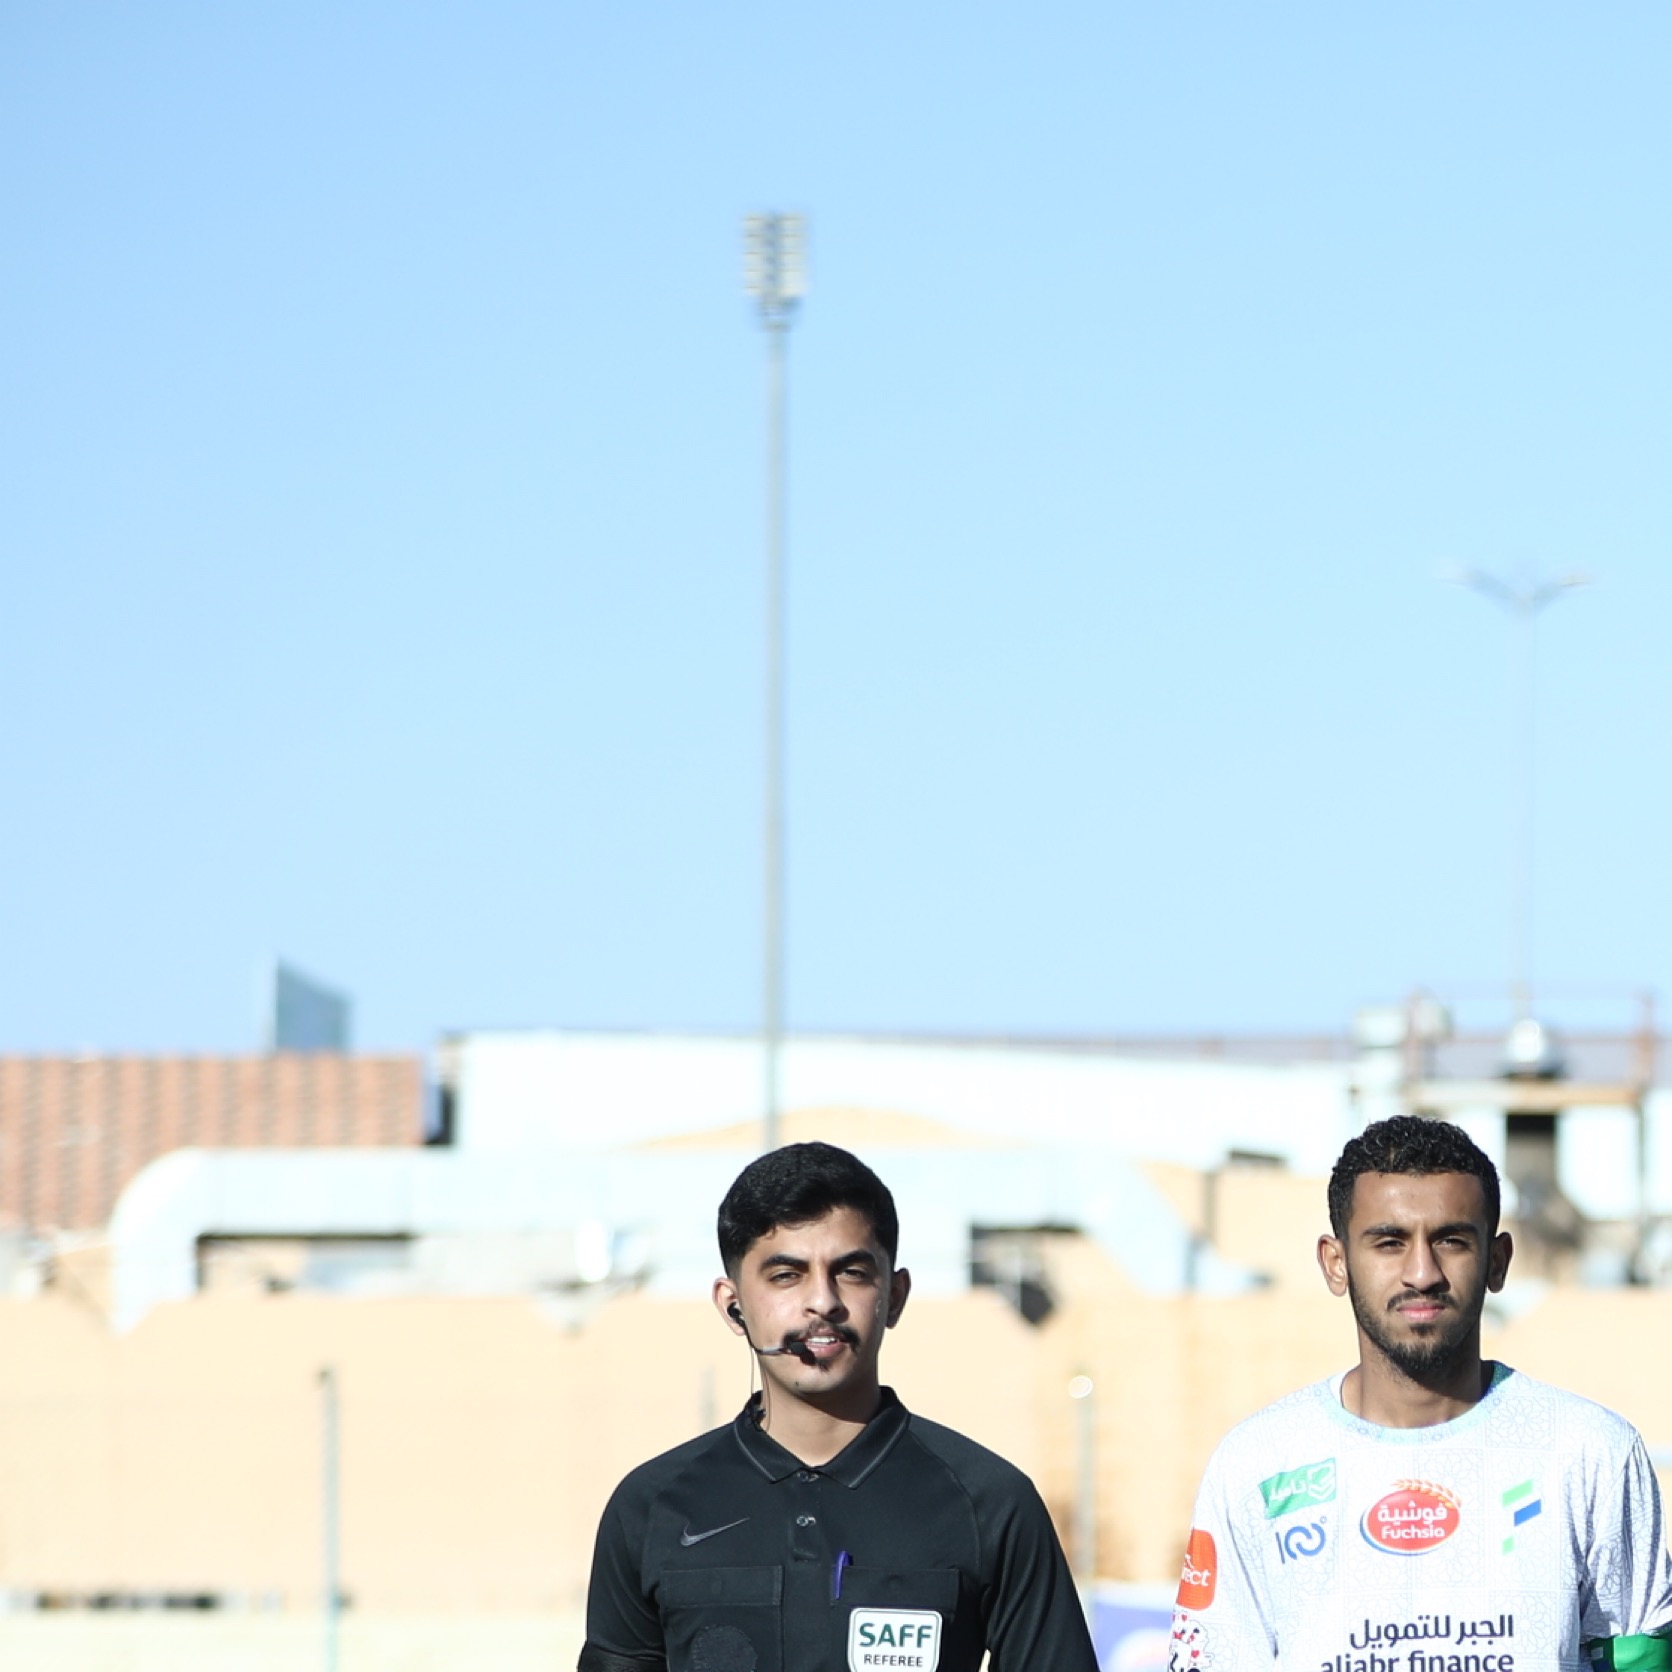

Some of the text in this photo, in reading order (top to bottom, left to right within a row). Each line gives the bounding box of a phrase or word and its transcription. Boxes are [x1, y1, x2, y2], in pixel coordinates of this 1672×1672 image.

[1381, 1524, 1446, 1540] Fuchsia
[859, 1622, 934, 1649] SAFF
[1349, 1614, 1515, 1650] الجبر للتمويل
[863, 1653, 924, 1668] REFEREE
